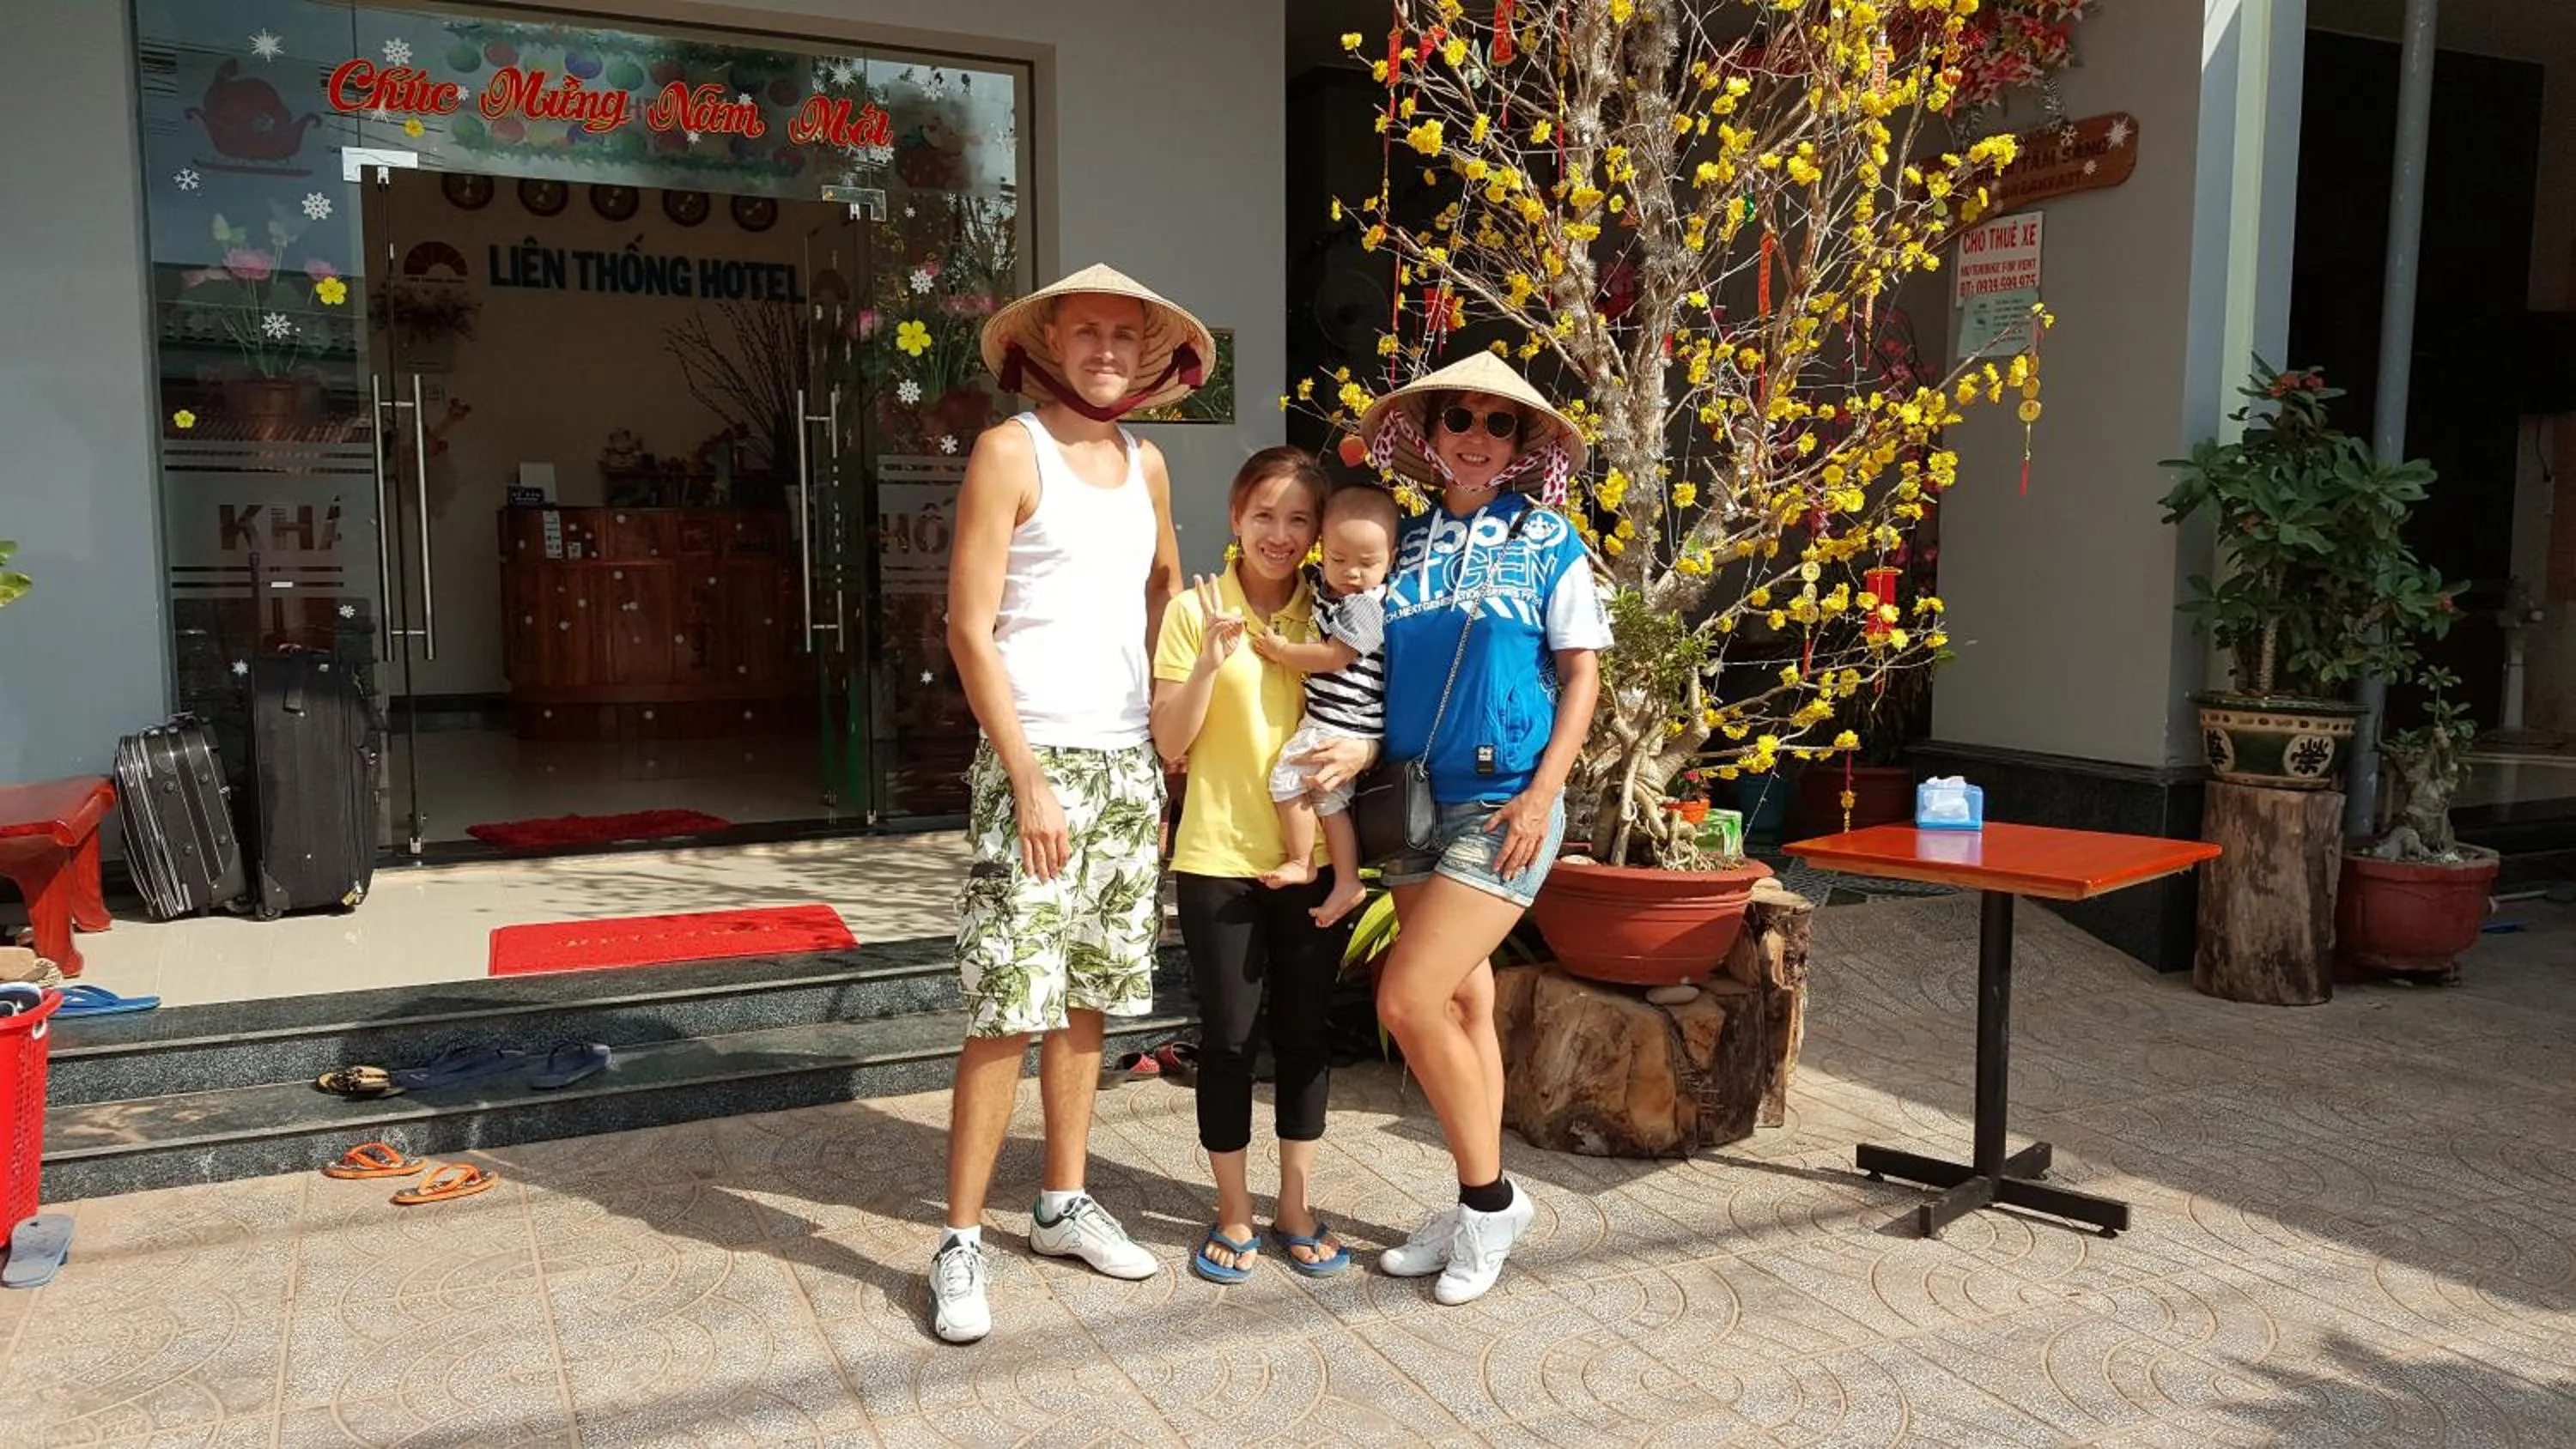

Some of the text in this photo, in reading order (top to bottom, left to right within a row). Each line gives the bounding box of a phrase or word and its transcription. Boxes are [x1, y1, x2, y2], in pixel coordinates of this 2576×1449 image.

[328, 58, 460, 113] Chúc
[1964, 230, 1985, 255] CHO
[2021, 224, 2038, 246] XE
[489, 233, 807, 304] LIÊN THỐNG HOTEL
